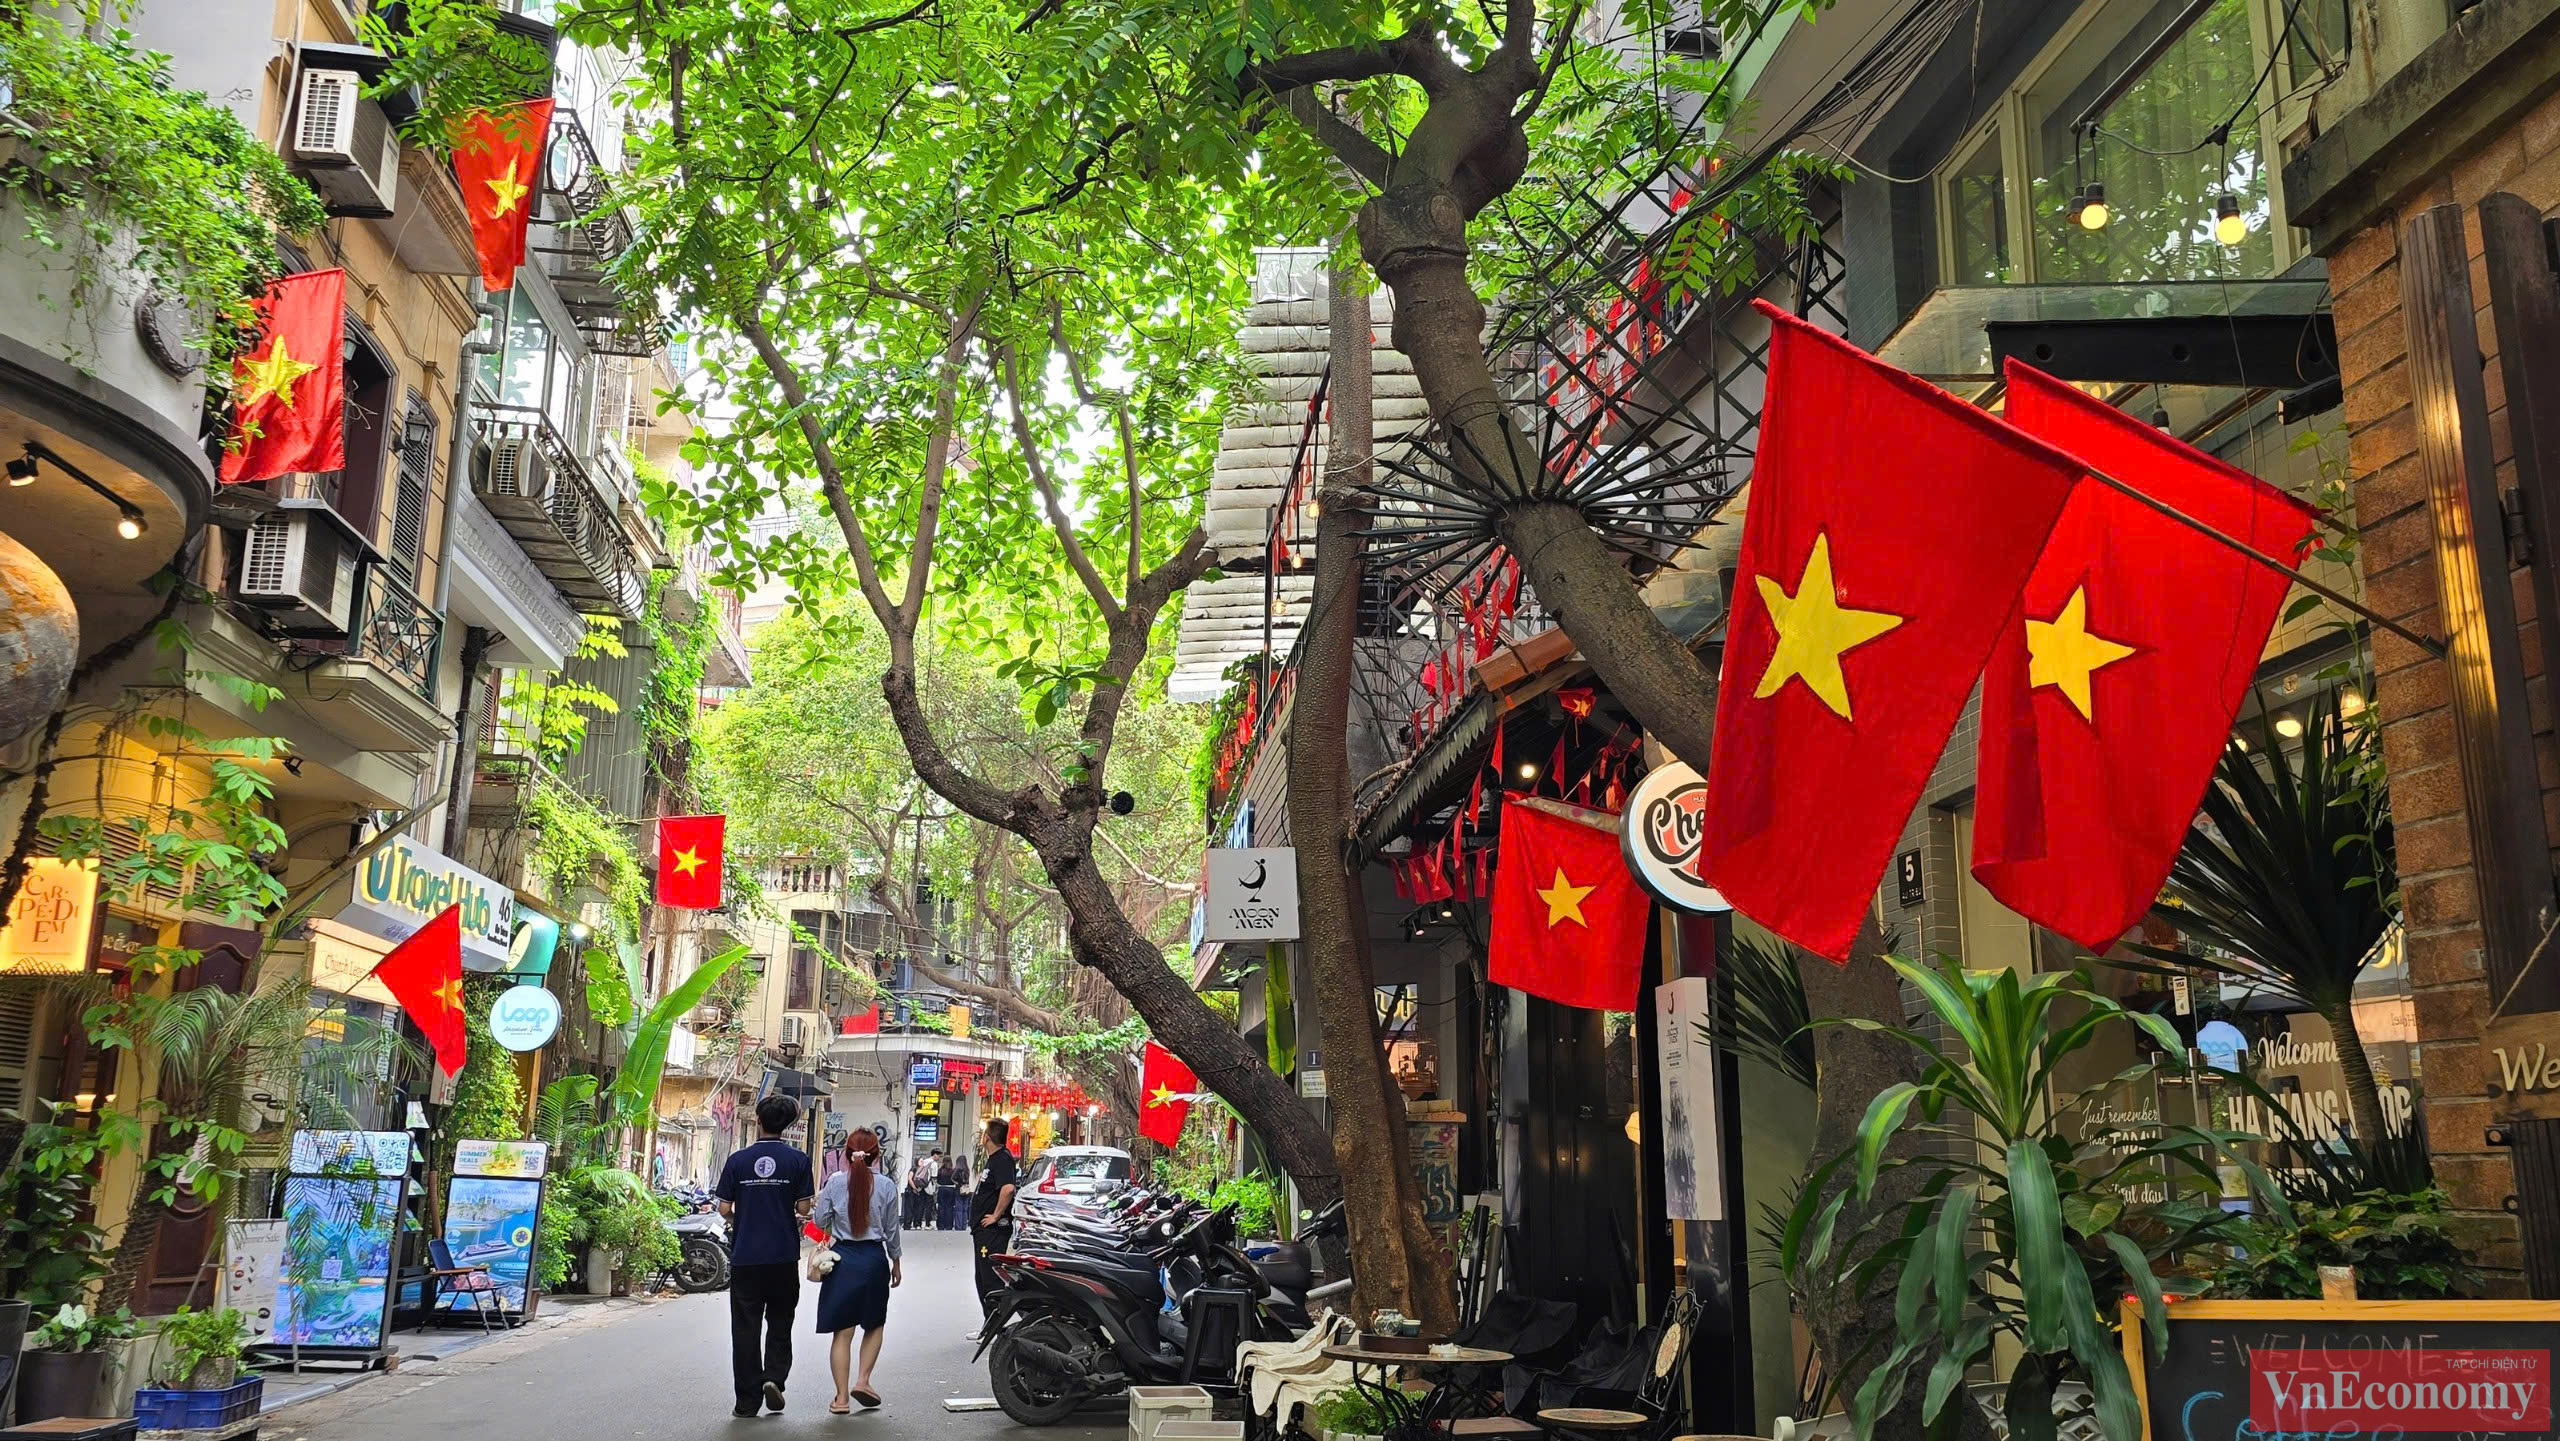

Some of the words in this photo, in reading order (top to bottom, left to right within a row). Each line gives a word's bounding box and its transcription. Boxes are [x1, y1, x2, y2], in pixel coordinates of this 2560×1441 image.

[1905, 855, 1915, 882] 5
[398, 846, 455, 914] Travel
[457, 877, 491, 937] Hub
[498, 896, 512, 923] 46
[1229, 907, 1280, 919] MOON
[32, 920, 66, 943] EM
[1235, 918, 1274, 929] MEN
[1311, 1052, 1316, 1065] 1
[2080, 1099, 2112, 1140] Just
[2109, 1096, 2159, 1123] remember
[2228, 1095, 2262, 1137] HA
[2346, 1086, 2412, 1140] LOP
[2231, 1332, 2445, 1379] WELCOME
